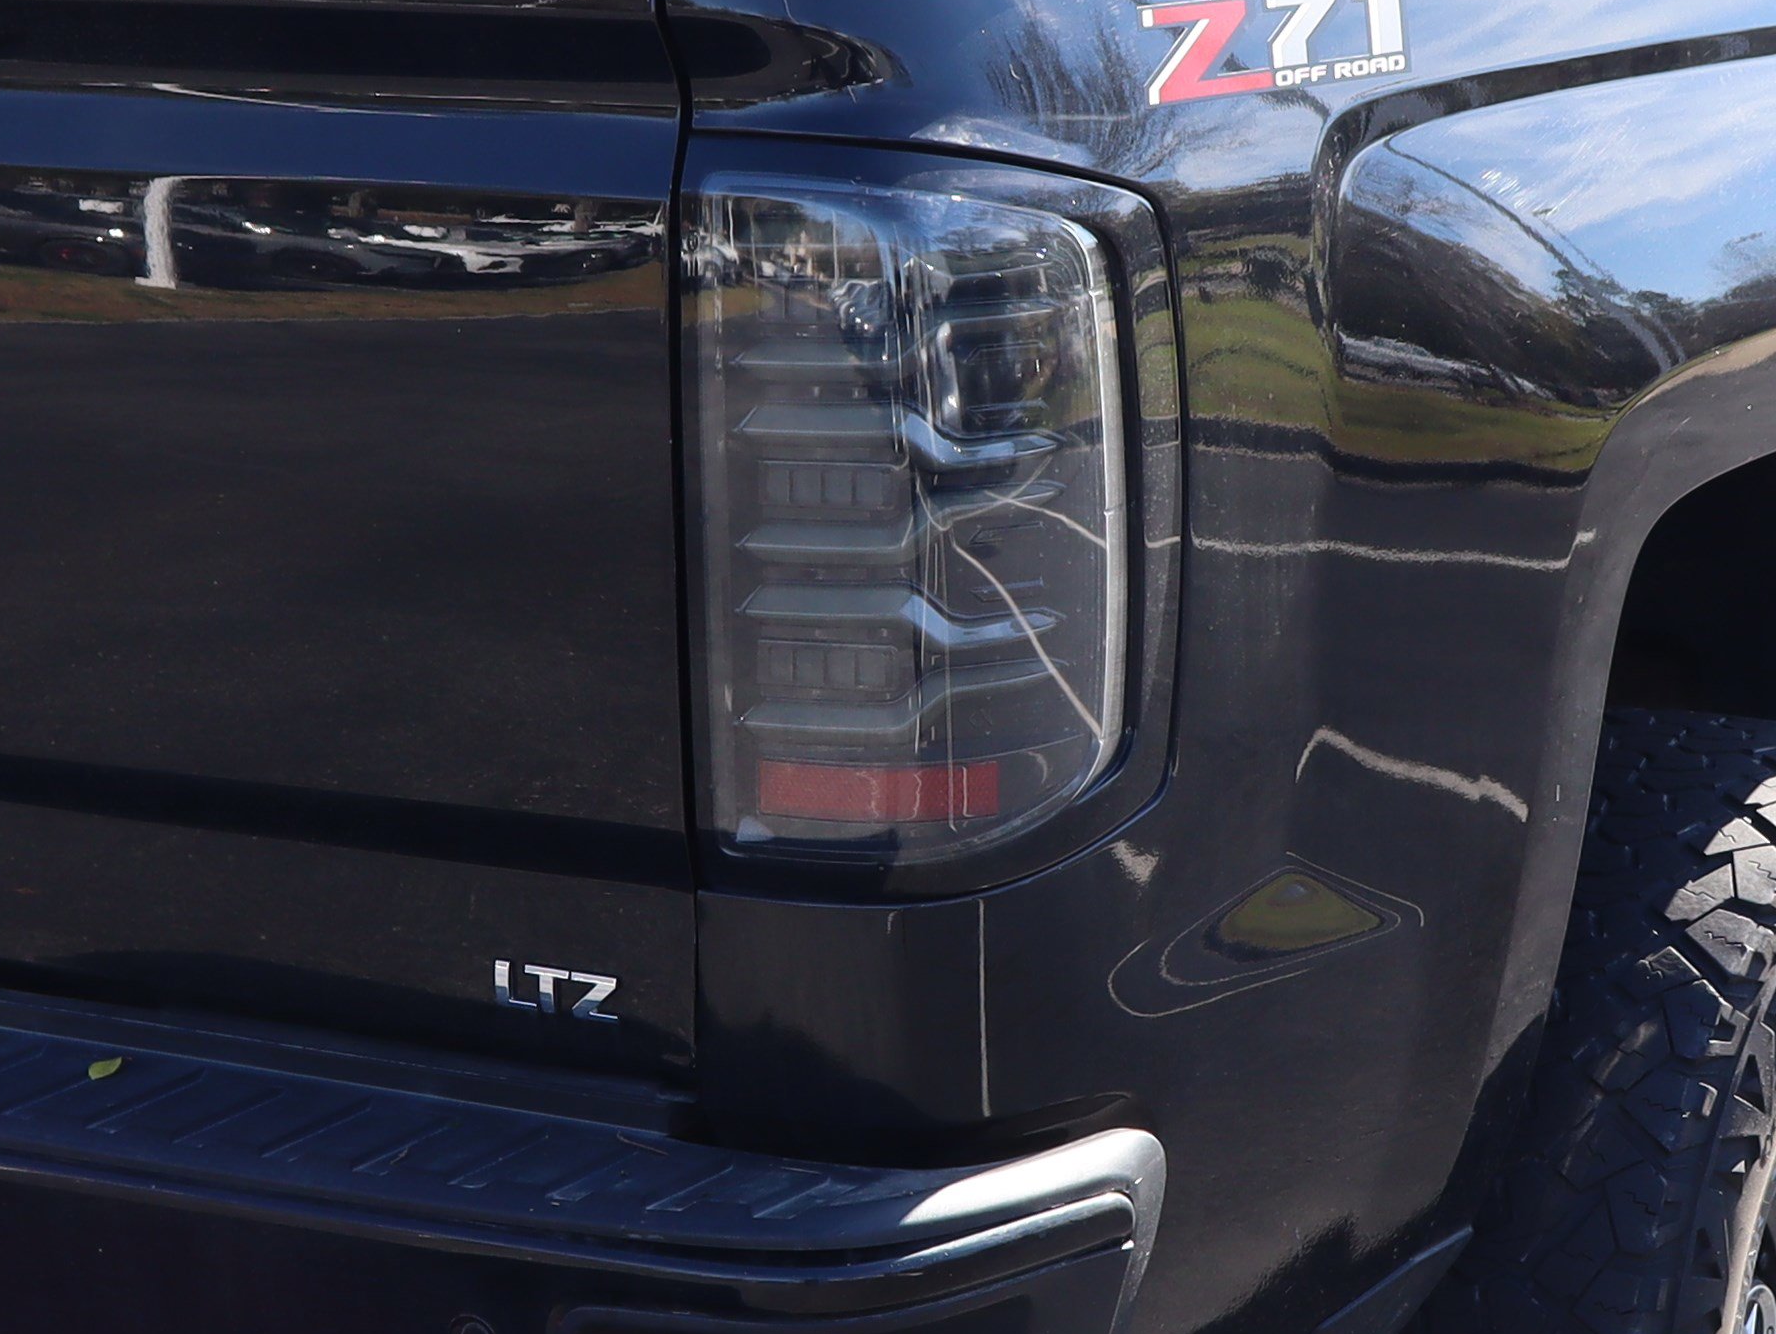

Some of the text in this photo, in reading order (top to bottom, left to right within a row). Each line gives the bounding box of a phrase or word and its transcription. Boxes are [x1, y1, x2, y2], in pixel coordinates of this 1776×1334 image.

[1275, 55, 1406, 88] OFF ROAD
[494, 959, 619, 1024] LTZ
